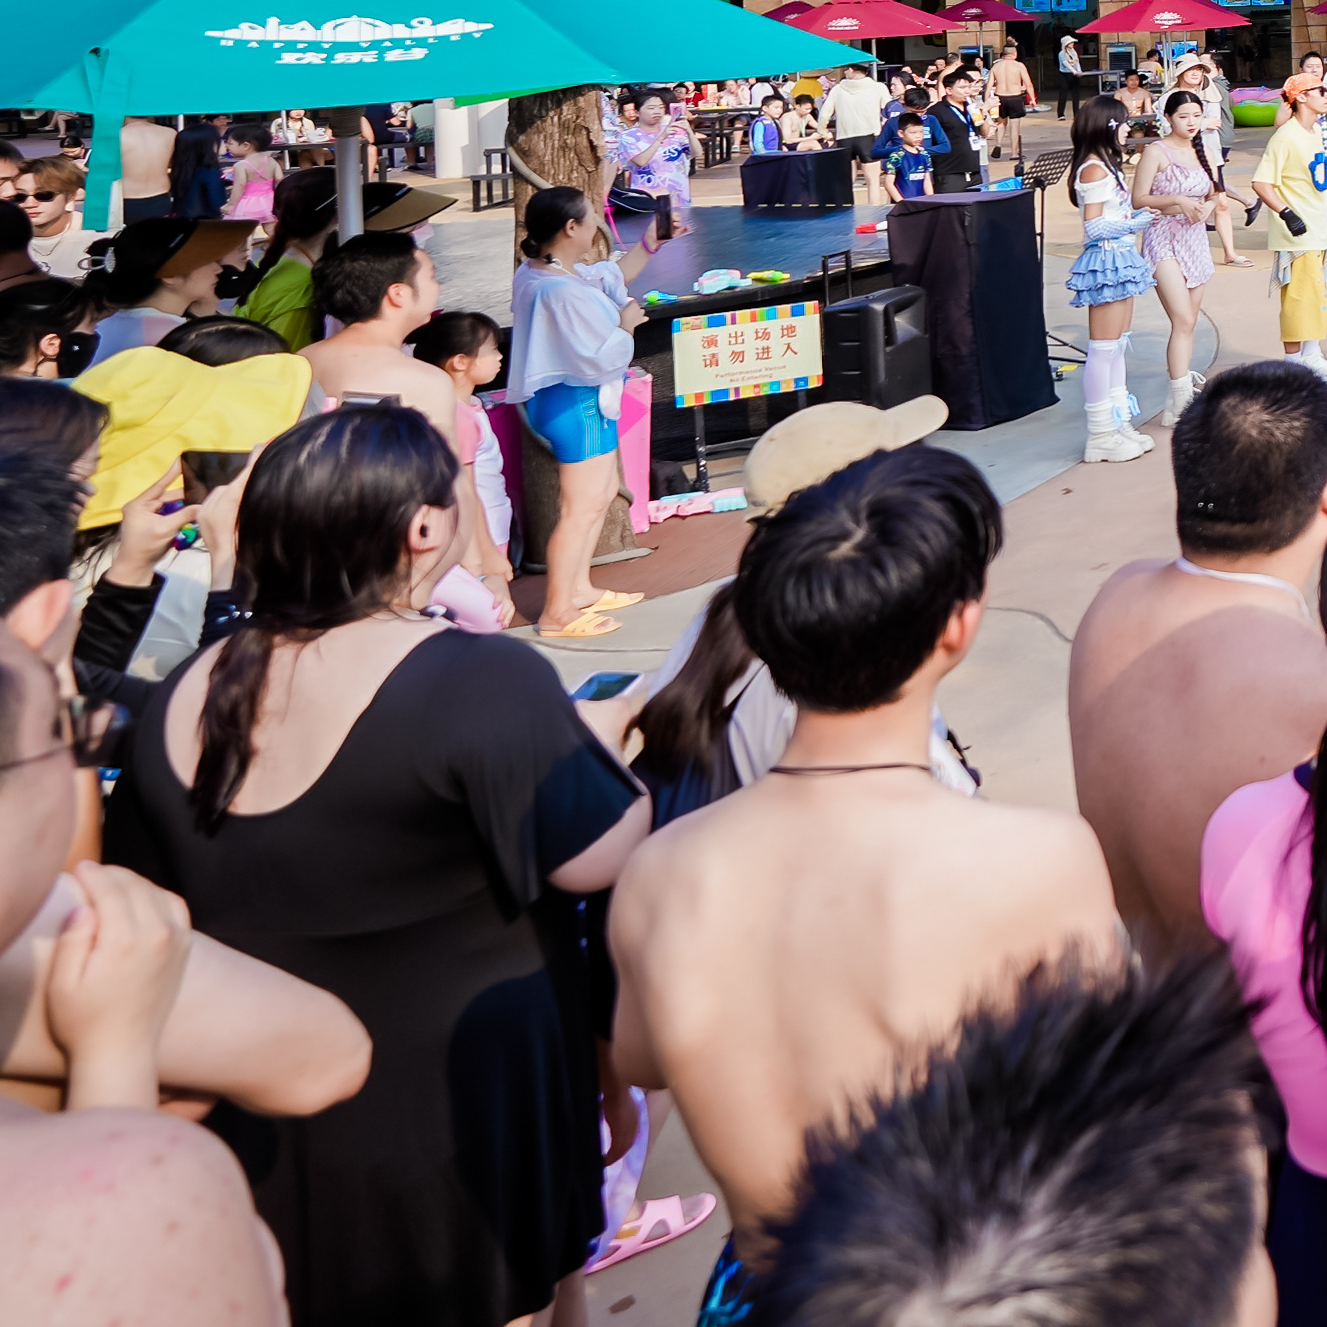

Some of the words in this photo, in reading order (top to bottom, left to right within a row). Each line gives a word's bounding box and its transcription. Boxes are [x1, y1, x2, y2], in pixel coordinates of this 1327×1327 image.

[274, 47, 430, 65] 欢乐谷
[702, 324, 797, 349] 演出场地
[703, 342, 798, 368] 请勿进入
